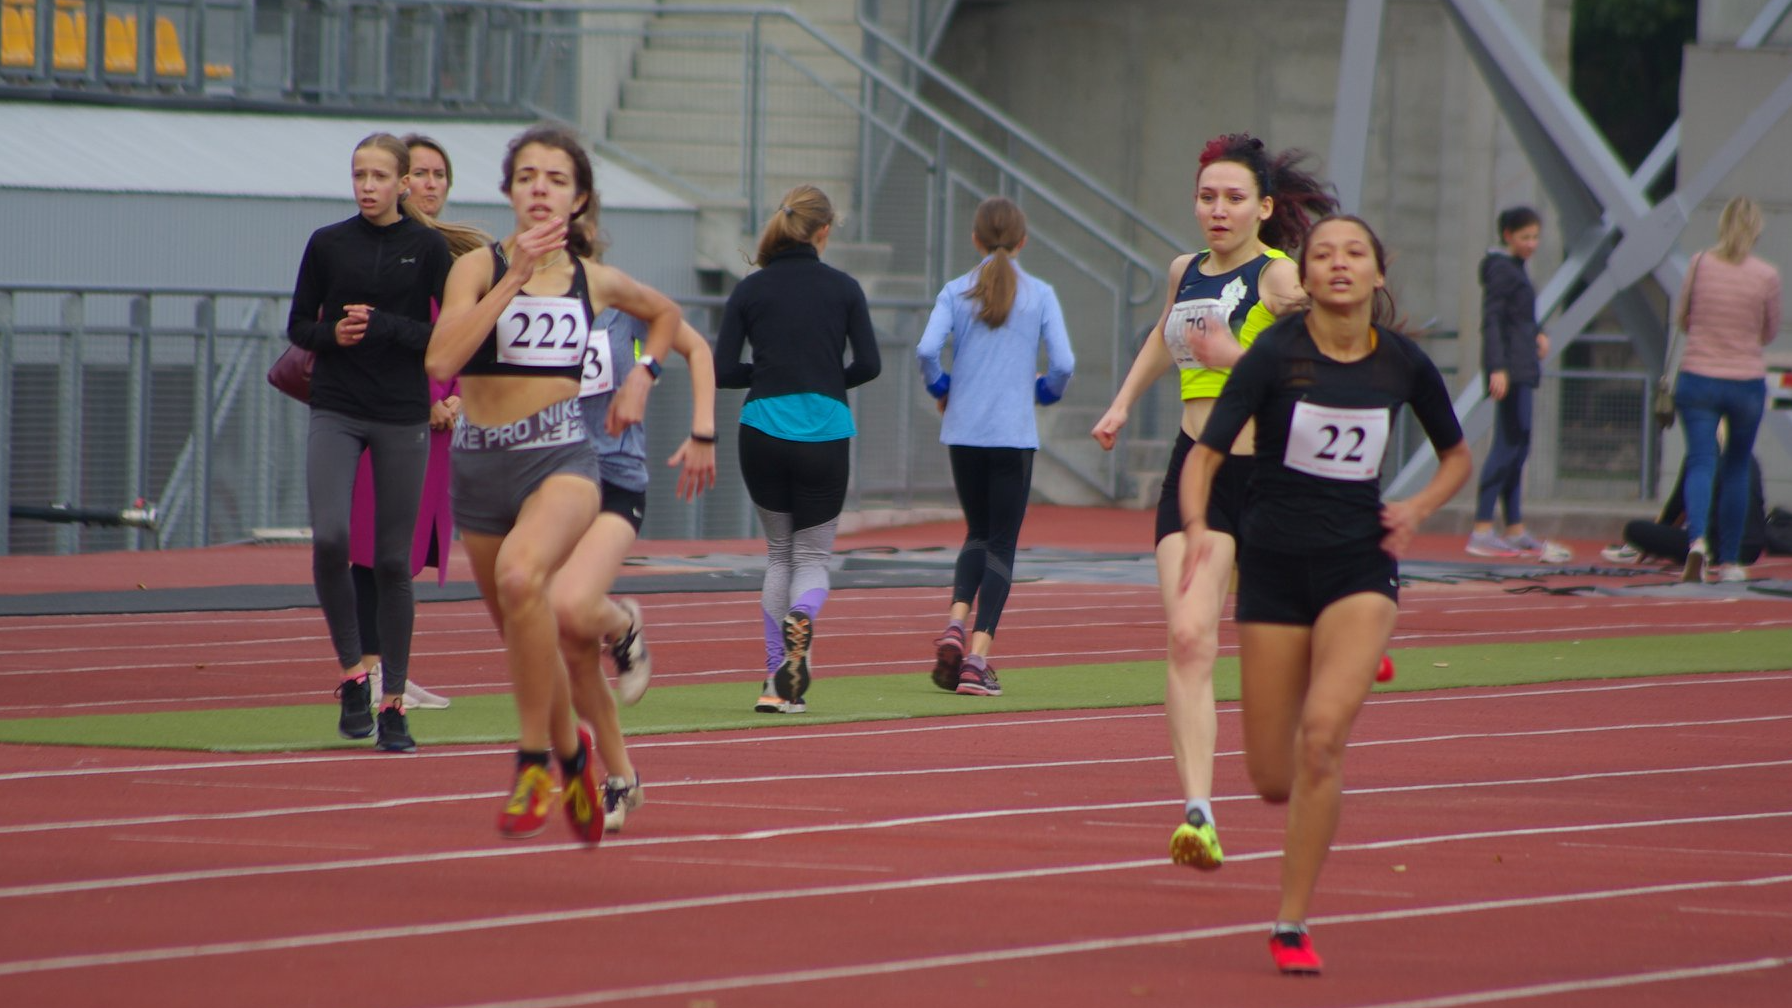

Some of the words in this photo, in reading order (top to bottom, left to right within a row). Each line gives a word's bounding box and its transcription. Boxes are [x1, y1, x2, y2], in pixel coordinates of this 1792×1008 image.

[508, 312, 579, 348] 222
[583, 346, 603, 380] 3
[484, 419, 531, 448] PRO
[538, 397, 583, 431] NIKE
[1313, 424, 1366, 462] 22
